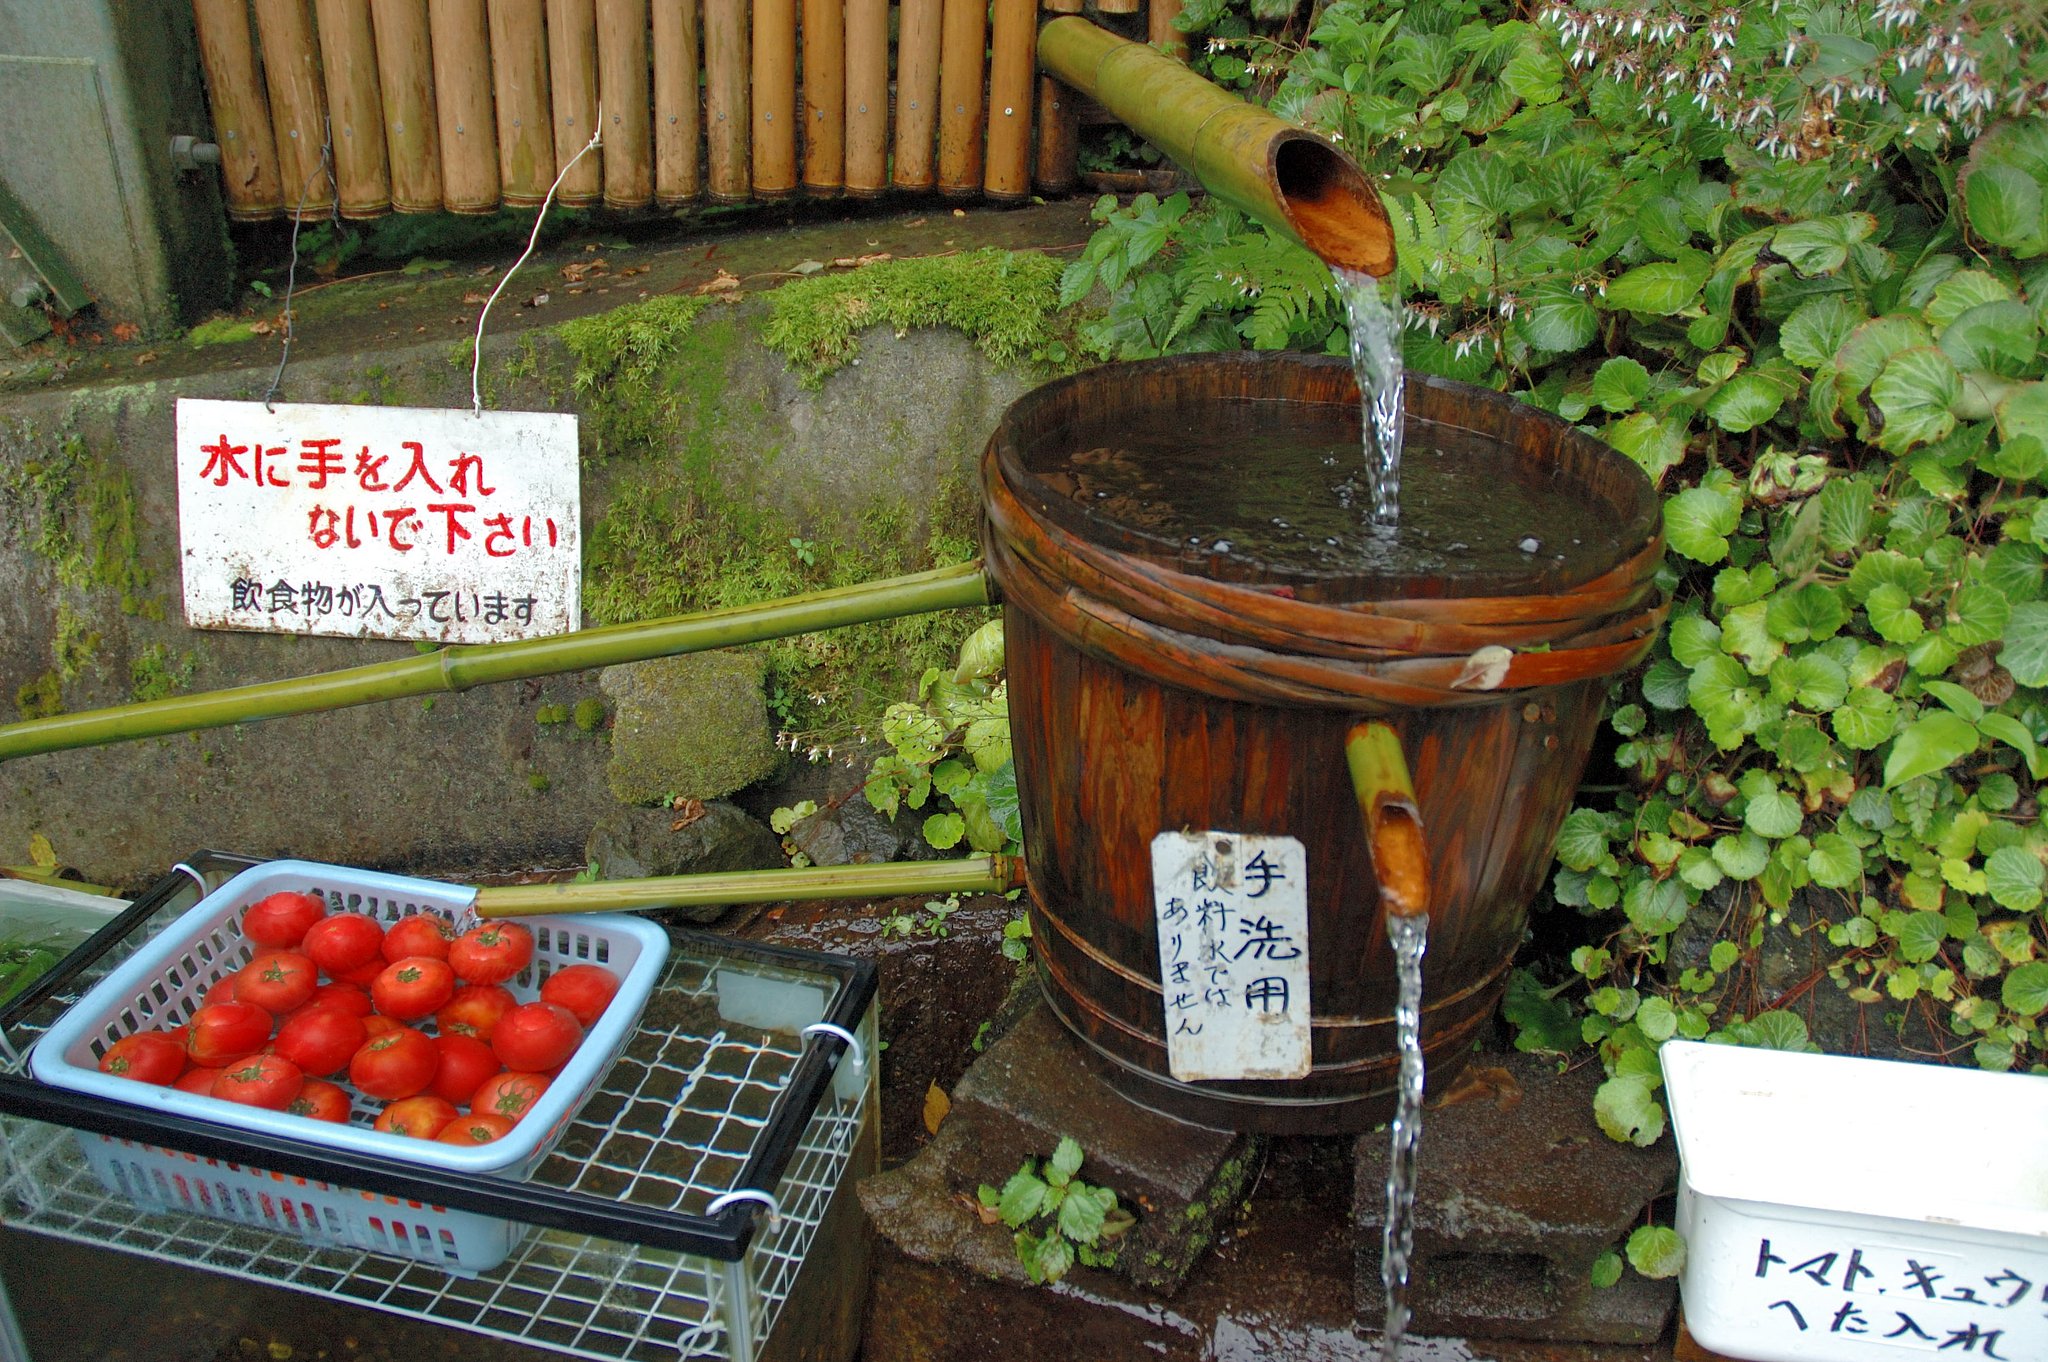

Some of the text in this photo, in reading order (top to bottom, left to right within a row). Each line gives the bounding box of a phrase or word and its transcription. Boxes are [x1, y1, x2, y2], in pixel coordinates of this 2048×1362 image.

[199, 434, 497, 498] 水に手を入れ
[307, 504, 558, 557] ないで下さい
[230, 577, 538, 627] 飲食物が入っています
[1233, 850, 1302, 1016] 手洗用
[1163, 897, 1204, 1036] ありません
[1768, 1299, 2011, 1361] へた入れ
